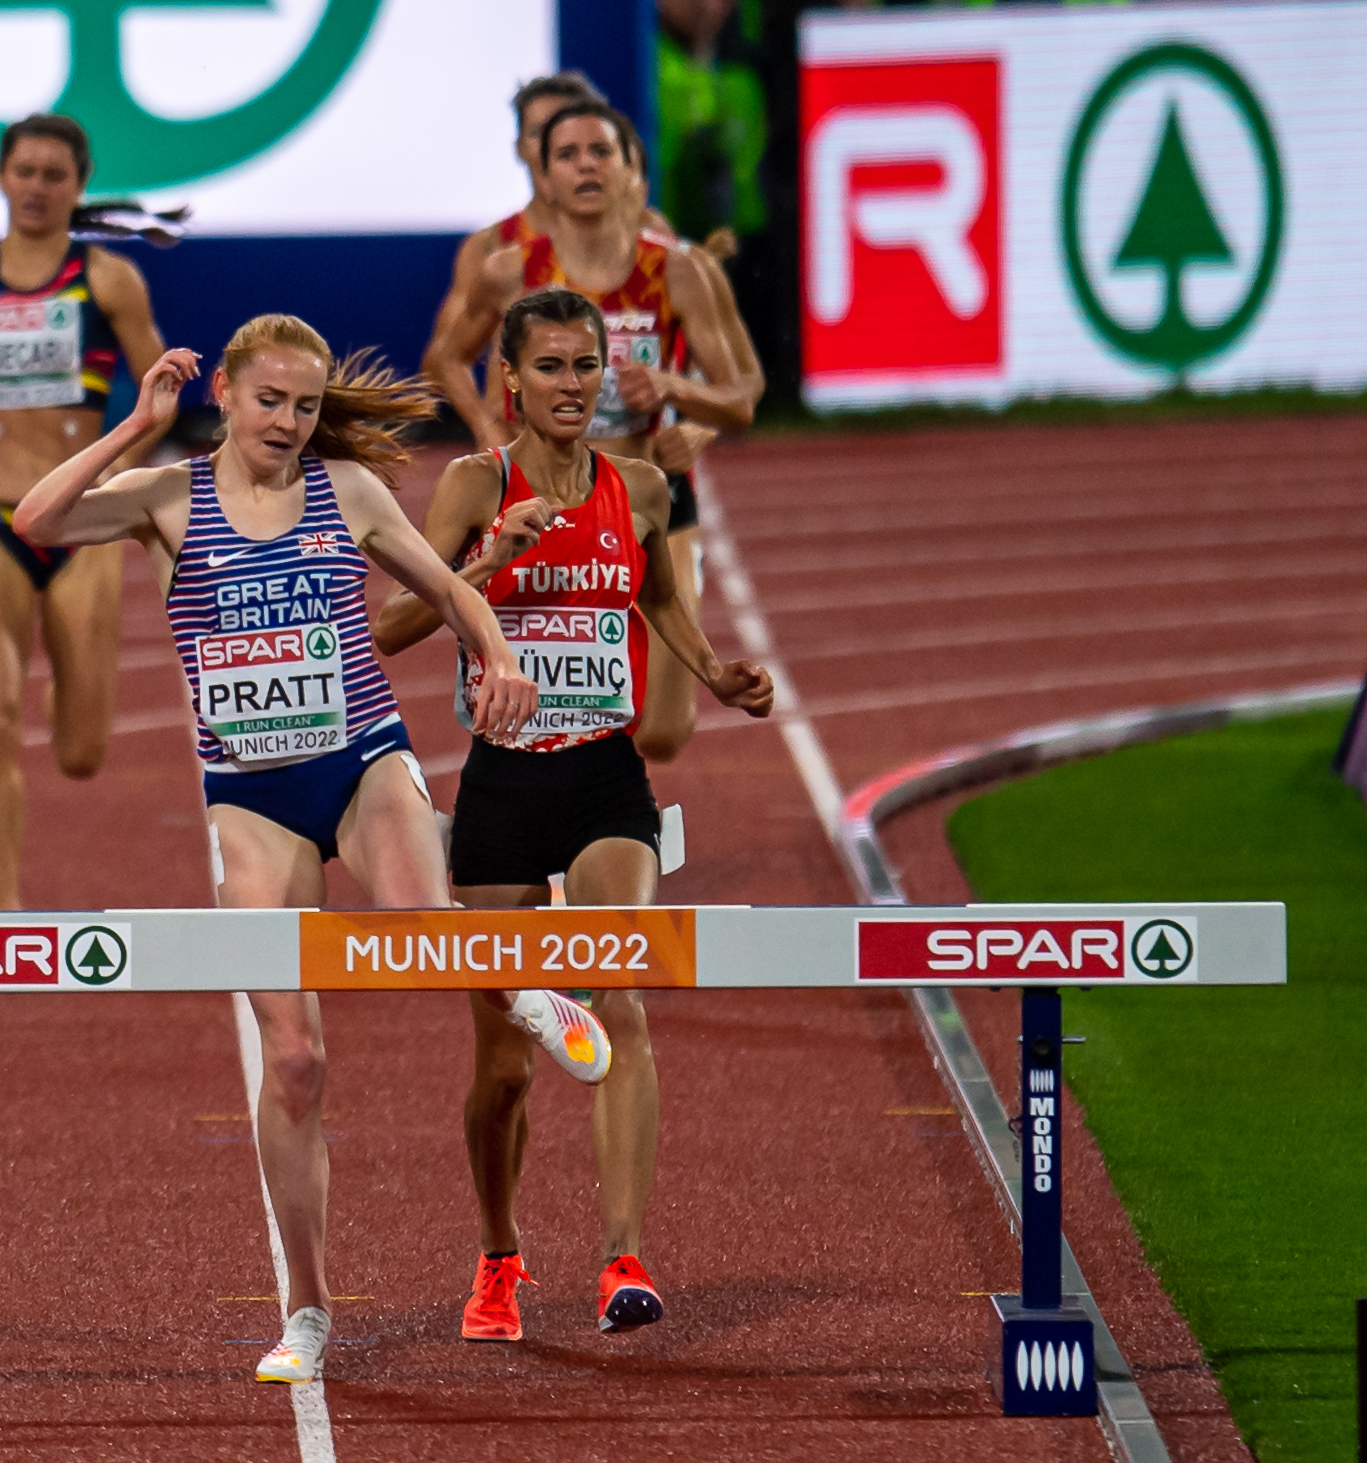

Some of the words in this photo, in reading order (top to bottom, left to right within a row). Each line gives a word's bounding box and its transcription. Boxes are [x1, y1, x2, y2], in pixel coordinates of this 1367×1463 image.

[809, 106, 989, 325] R
[217, 573, 331, 607] GREAT
[512, 558, 631, 593] TÜRKİYE
[220, 598, 331, 630] BRITAIN
[501, 614, 594, 638] SPAR
[202, 634, 301, 666] SPAR
[519, 648, 626, 697] ÜVENÇ
[208, 672, 335, 717] PRATT
[537, 696, 558, 707] UN
[560, 696, 601, 707] CLEAN
[243, 719, 270, 732] RUN
[272, 715, 312, 730] CLEAN
[528, 712, 575, 728] NICH
[294, 729, 339, 749] 2022
[346, 934, 523, 972] MUNICH
[541, 933, 649, 971] 2022
[927, 929, 1119, 971] SPAR
[1030, 1097, 1055, 1193] MONDO
